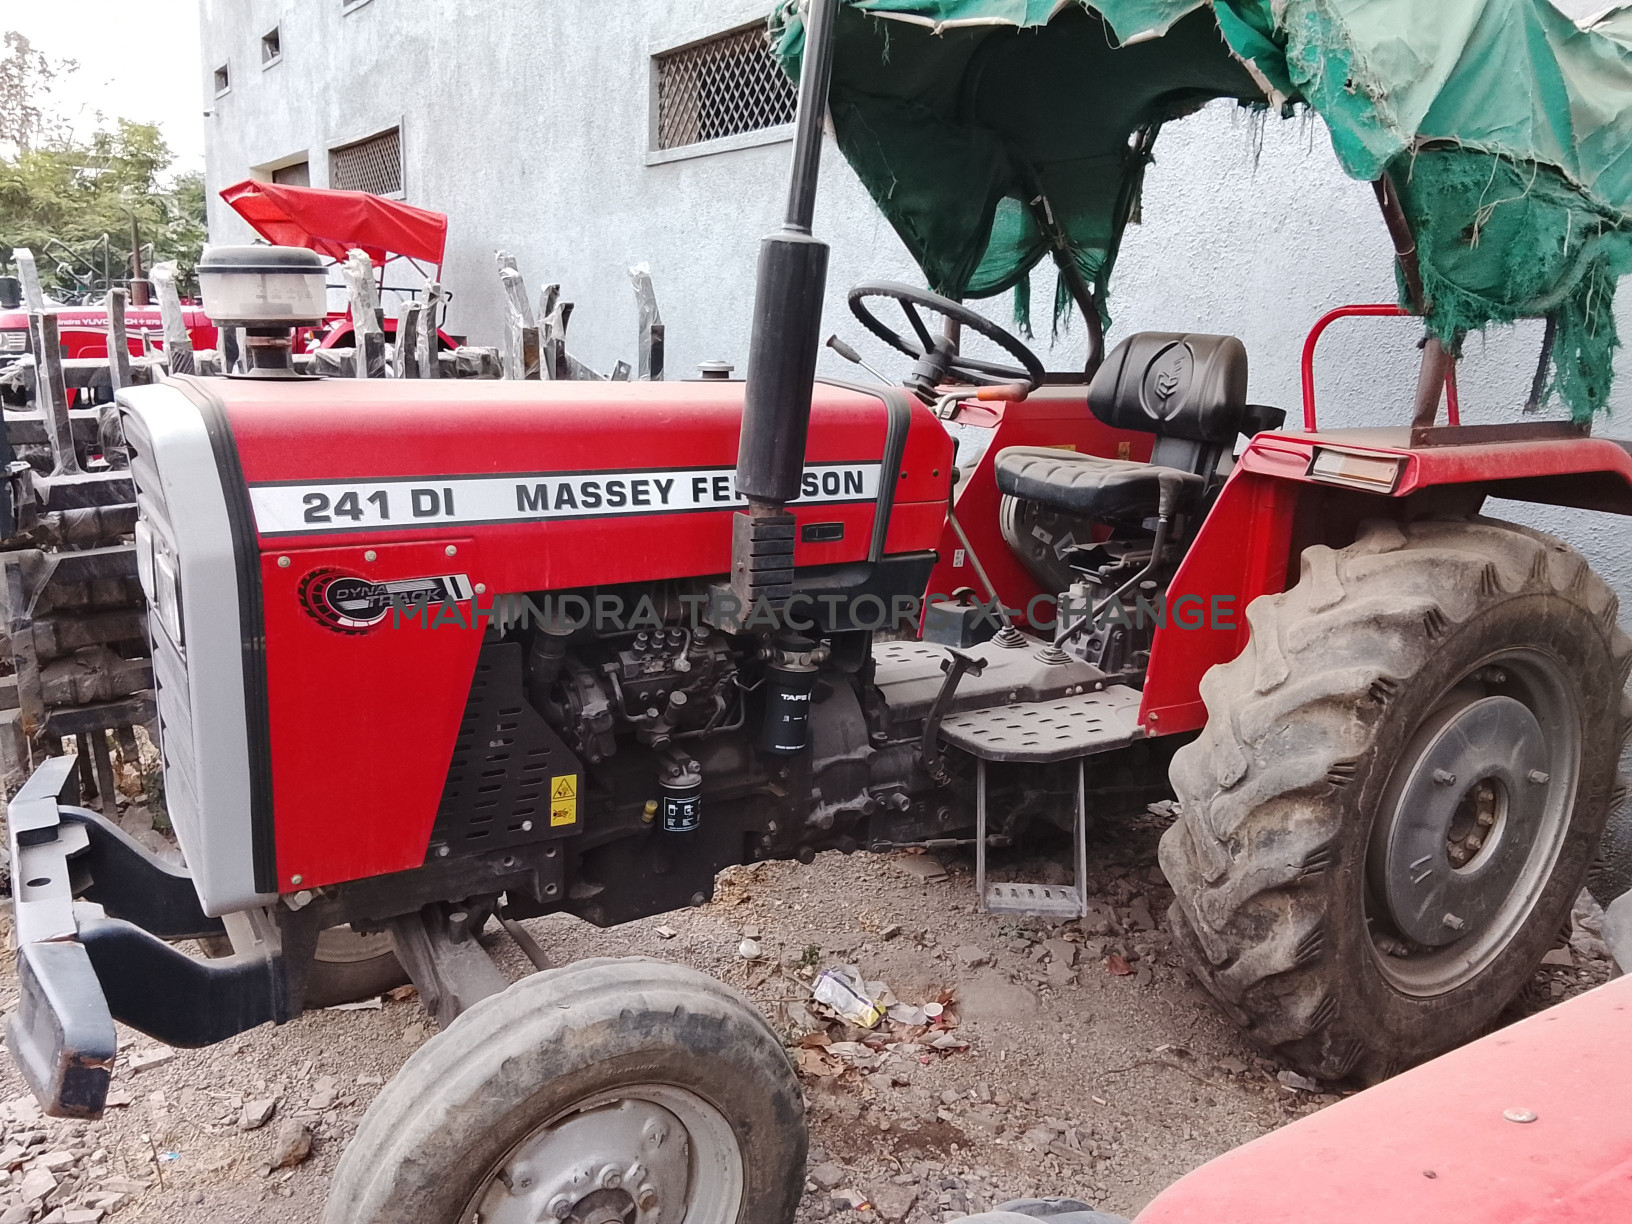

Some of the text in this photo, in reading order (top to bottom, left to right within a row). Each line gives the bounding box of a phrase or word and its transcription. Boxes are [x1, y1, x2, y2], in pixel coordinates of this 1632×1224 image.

[515, 470, 864, 512] MASSEY FESON
[302, 487, 455, 524] 241 DI
[335, 584, 388, 600] DYNA
[365, 588, 442, 608] TRACK
